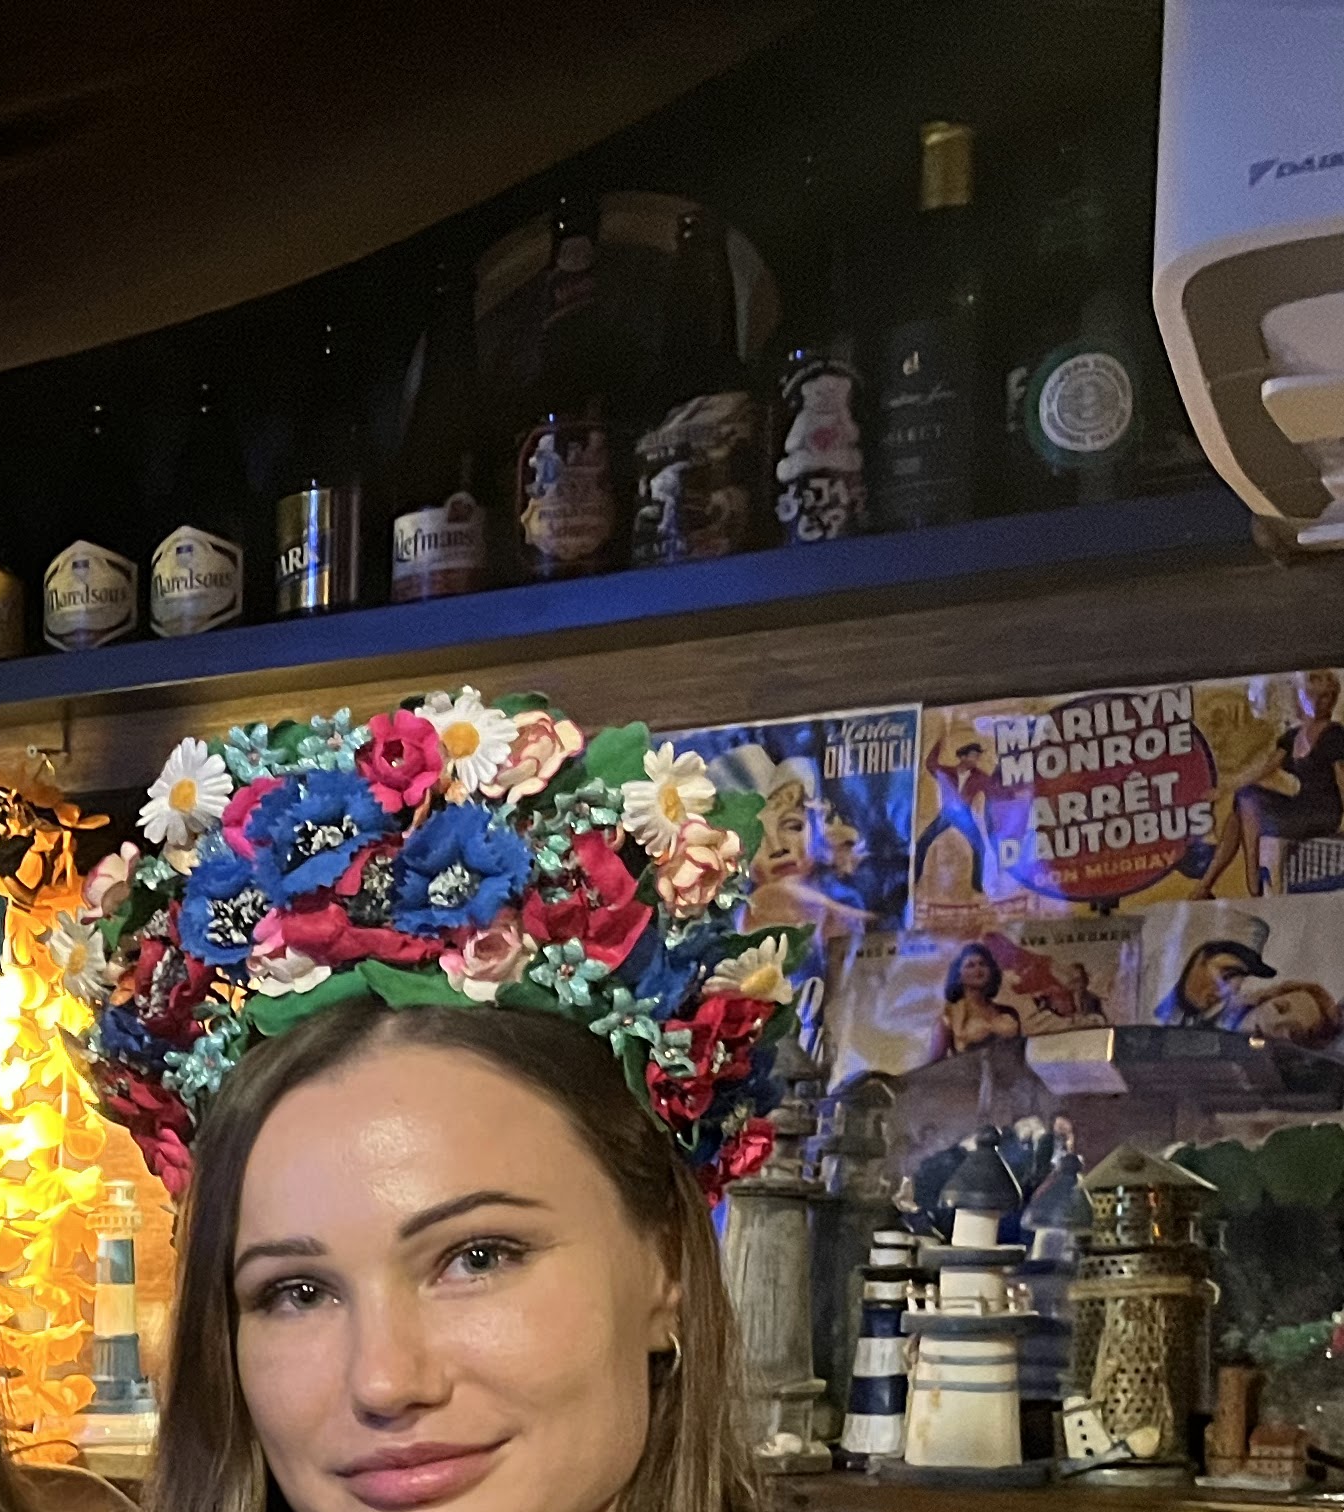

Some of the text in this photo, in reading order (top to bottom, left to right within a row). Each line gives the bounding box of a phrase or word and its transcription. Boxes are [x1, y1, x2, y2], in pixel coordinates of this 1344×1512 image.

[994, 686, 1194, 755] MARILYN
[823, 737, 914, 780] DIETRICH
[999, 721, 1194, 788] MONROE
[1029, 768, 1181, 829] ARRÊT
[1084, 852, 1178, 881] MURRAY
